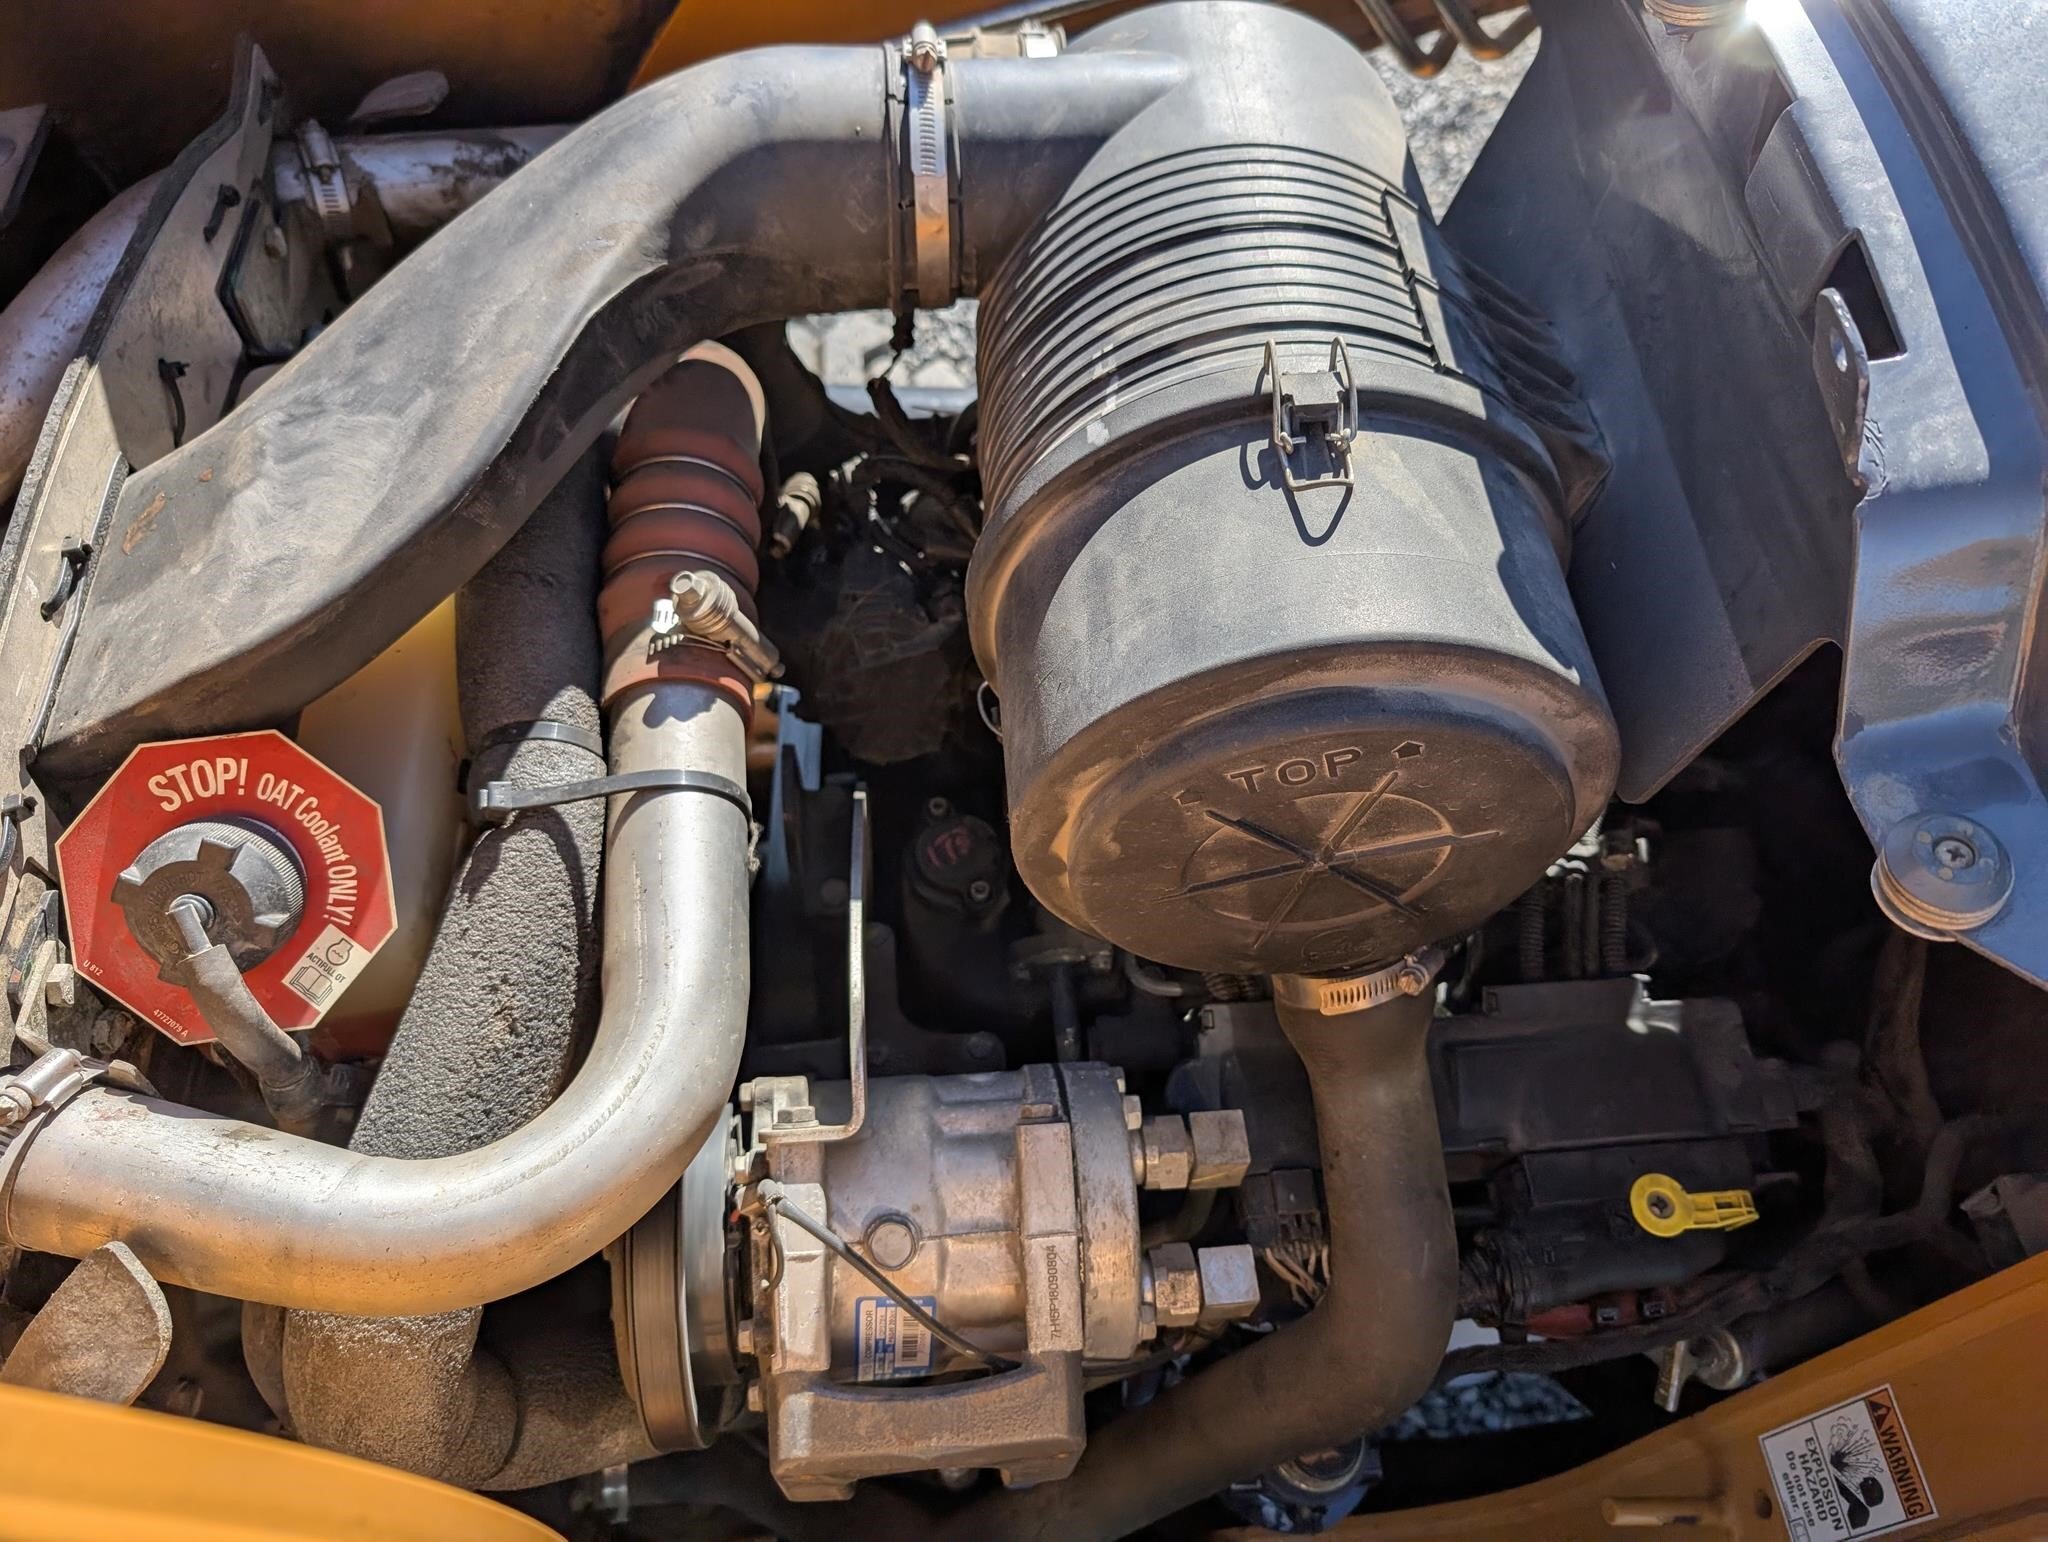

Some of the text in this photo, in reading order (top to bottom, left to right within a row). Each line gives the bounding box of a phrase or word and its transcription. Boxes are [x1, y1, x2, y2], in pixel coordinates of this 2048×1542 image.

[1229, 746, 1362, 793] TOP
[148, 758, 357, 926] STOP! OAT Coolant ONLY!
[89, 964, 103, 976] 812
[307, 952, 346, 983] ACTIFULL OT
[864, 1310, 873, 1359] COMPRESSOR
[1782, 1472, 1801, 1513] ether.
[1785, 1451, 1815, 1527] Do not use
[1799, 1453, 1828, 1522] HAZARD
[1805, 1437, 1844, 1531] EXPLOSION
[1880, 1425, 1924, 1516] WARNING
